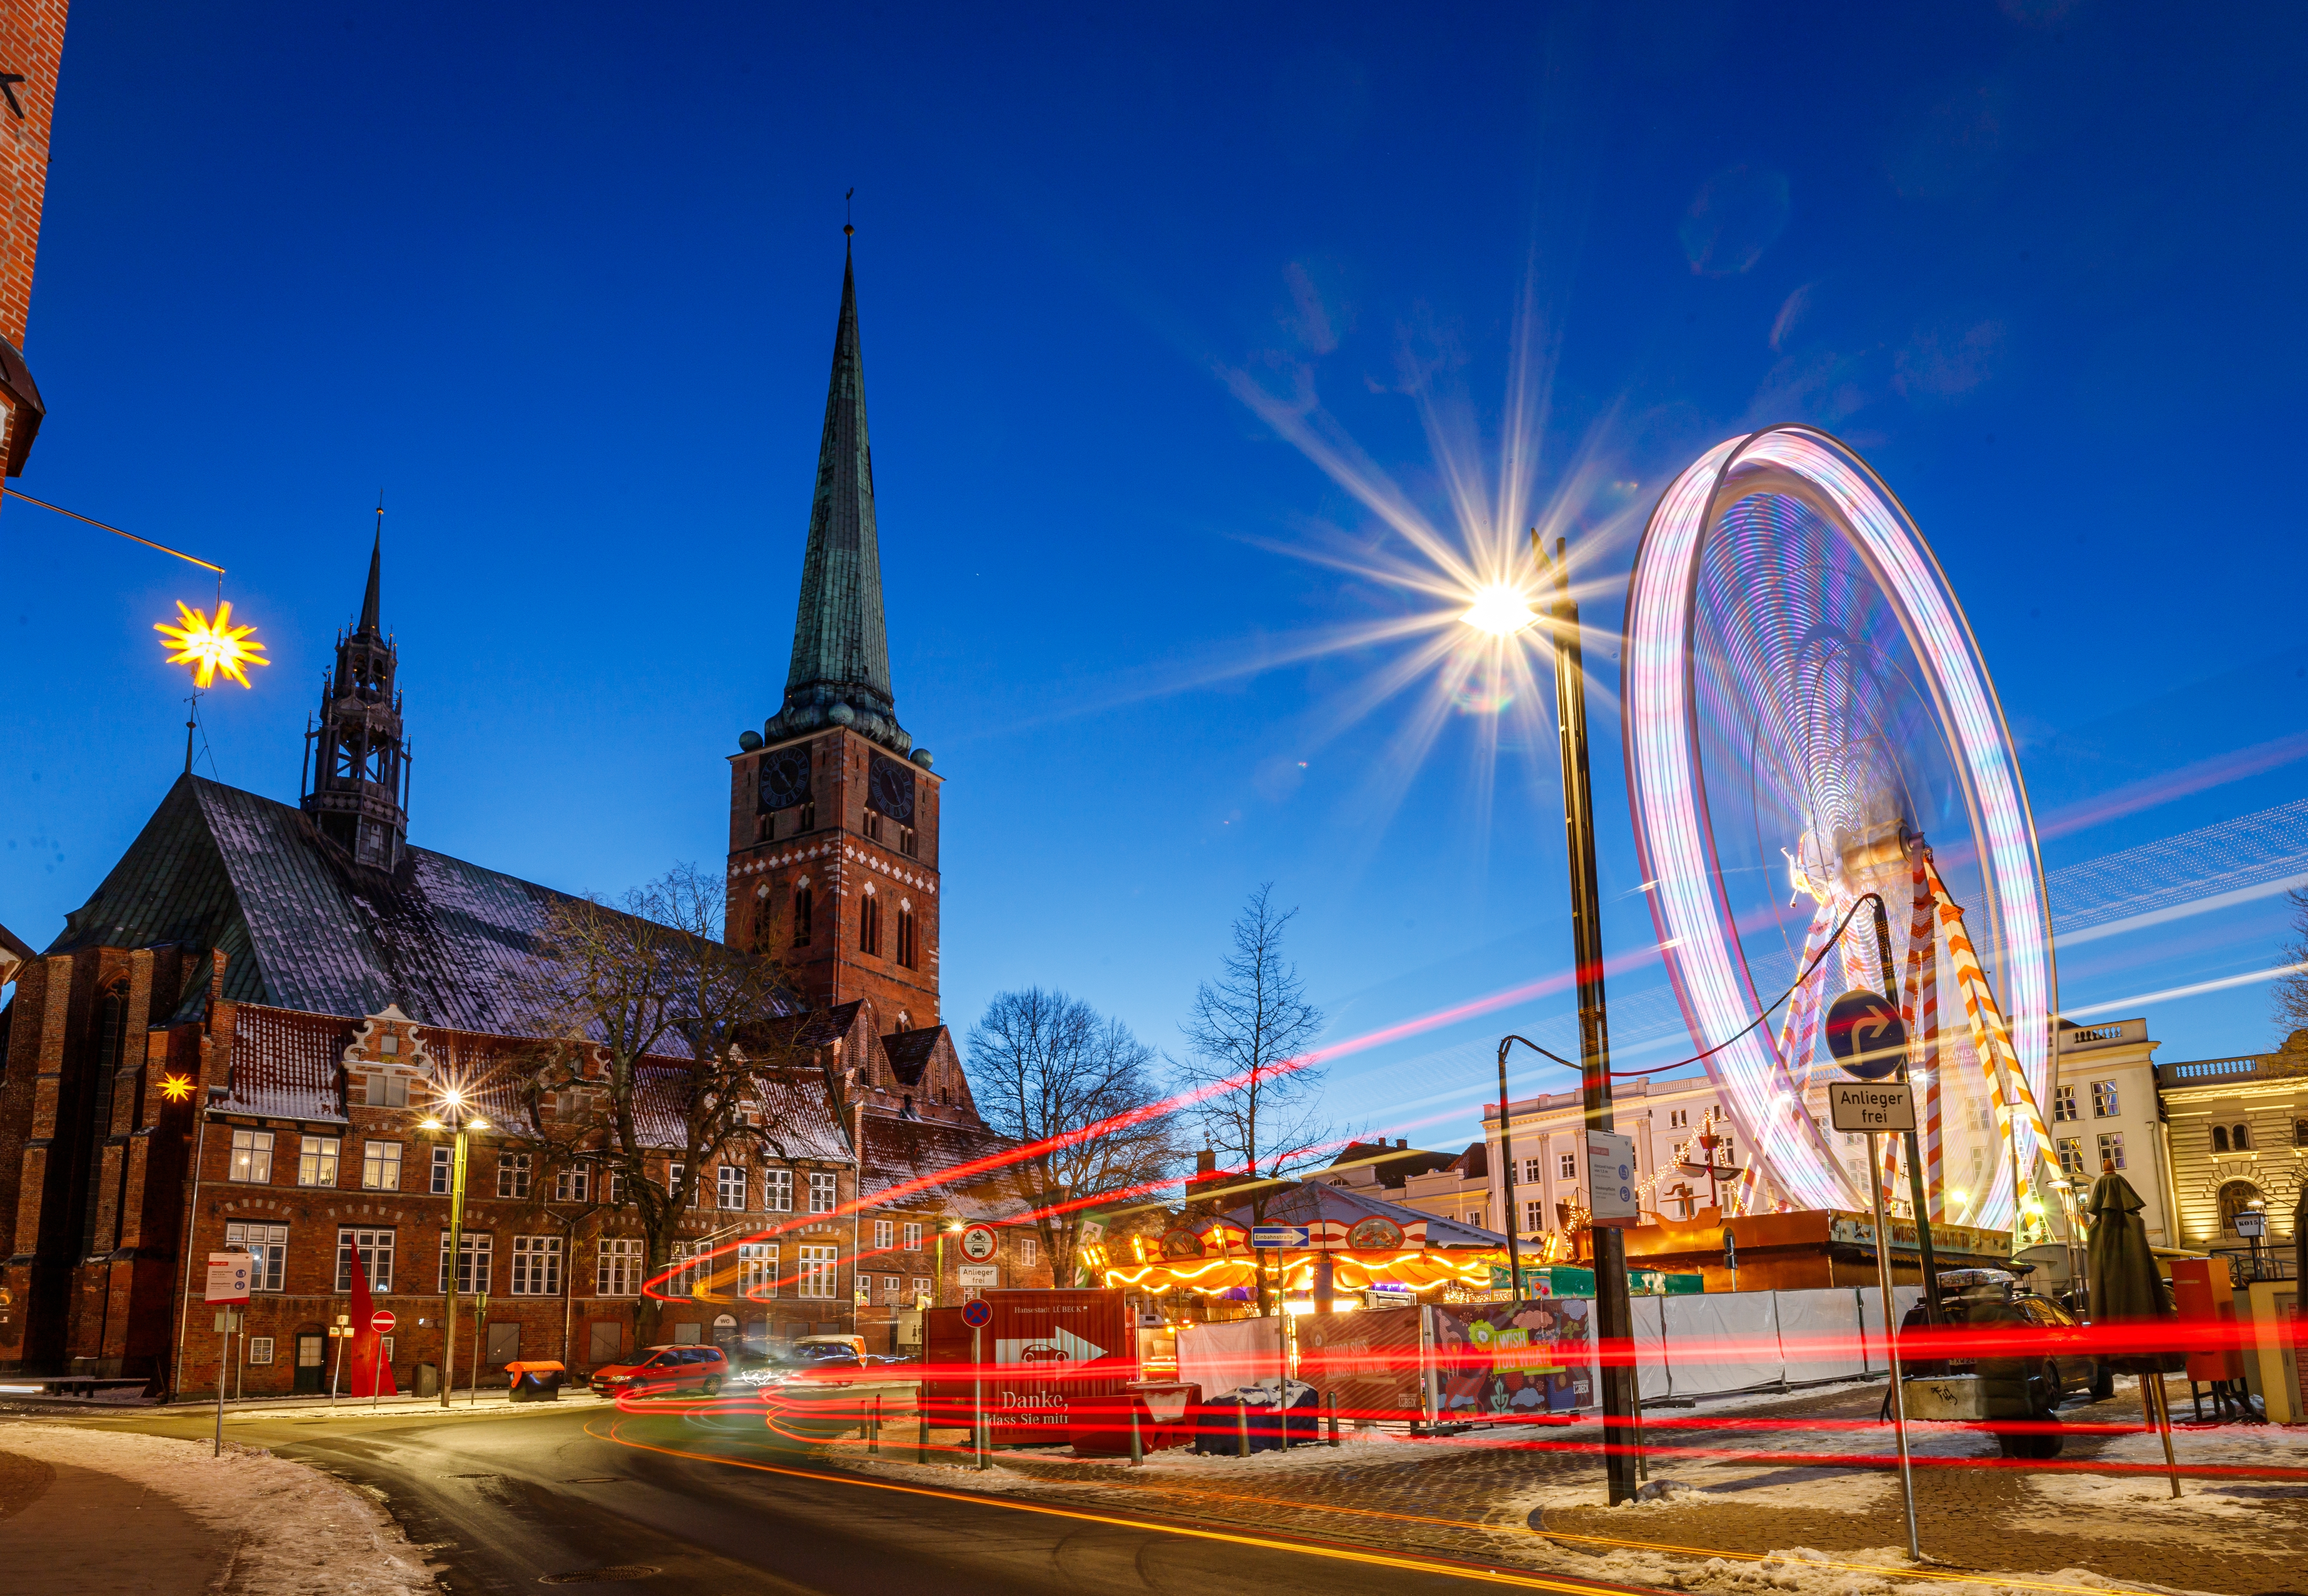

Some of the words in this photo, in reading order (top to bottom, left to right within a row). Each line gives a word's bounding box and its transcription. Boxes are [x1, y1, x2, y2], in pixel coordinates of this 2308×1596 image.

[1841, 1091, 1903, 1108] Anlieger
[1861, 1109, 1887, 1123] frei
[963, 1268, 993, 1277] Anlieger
[1499, 1331, 1527, 1350] WISH
[1495, 1352, 1516, 1370] YOU
[1517, 1348, 1550, 1367] WHAT.
[1325, 1359, 1355, 1380] KLINGST
[1573, 1384, 1589, 1395] LÜBECK
[1002, 1390, 1069, 1412] Danke,
[1398, 1398, 1417, 1408] LÜBECK
[989, 1414, 1016, 1426] dass
[1021, 1413, 1039, 1425] Sie
